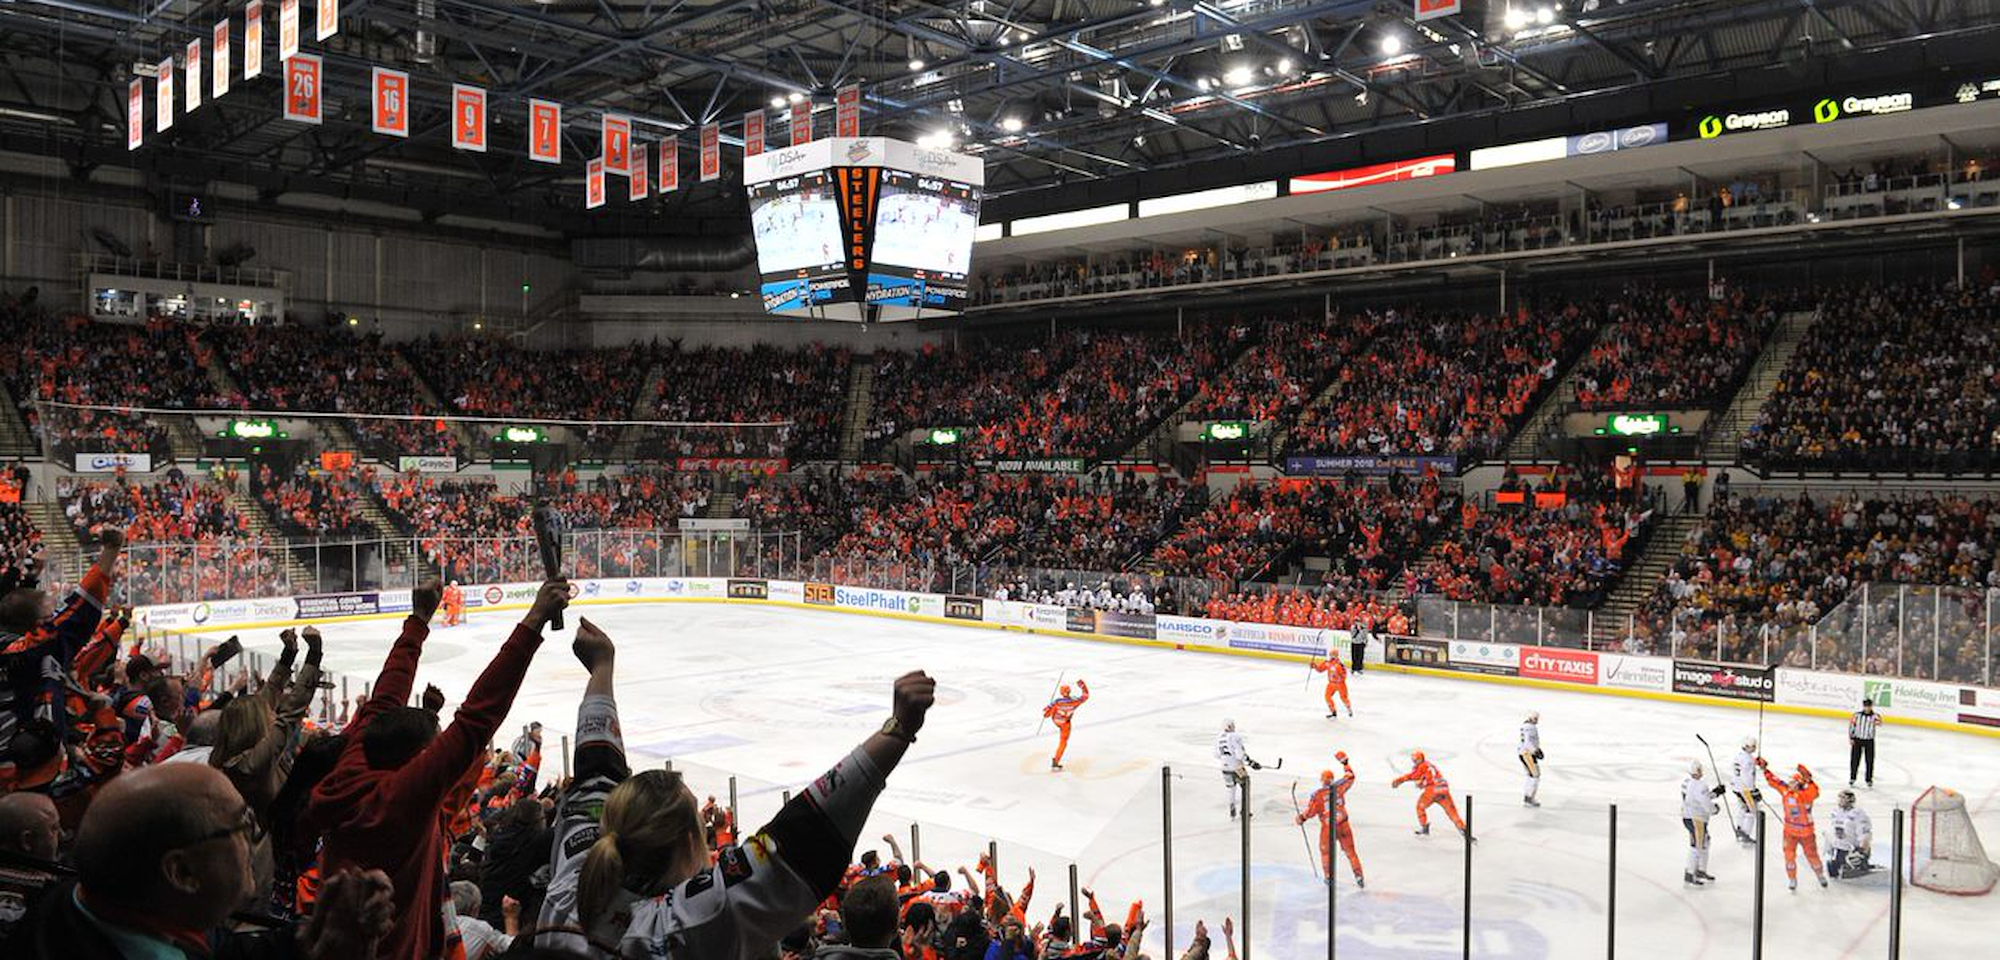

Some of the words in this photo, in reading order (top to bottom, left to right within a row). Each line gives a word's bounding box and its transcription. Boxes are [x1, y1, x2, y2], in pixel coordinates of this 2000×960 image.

[293, 74, 313, 98] 26
[382, 88, 400, 114] 16
[1843, 93, 1912, 114] Grayson
[464, 104, 476, 128] 9
[1725, 109, 1789, 129] Grayson
[540, 118, 549, 141] 7
[611, 132, 621, 154] 4
[852, 168, 864, 270] STEELERS
[996, 460, 1023, 471] NOW
[1025, 460, 1081, 472] AVAILABLE
[1315, 459, 1353, 468] SUMMER
[836, 588, 905, 611] SteelPhalt
[1158, 622, 1212, 634] HARSCO
[1557, 659, 1594, 674] TAXIS
[1895, 685, 1936, 702] Holiday
[1937, 689, 1956, 703] Inn
